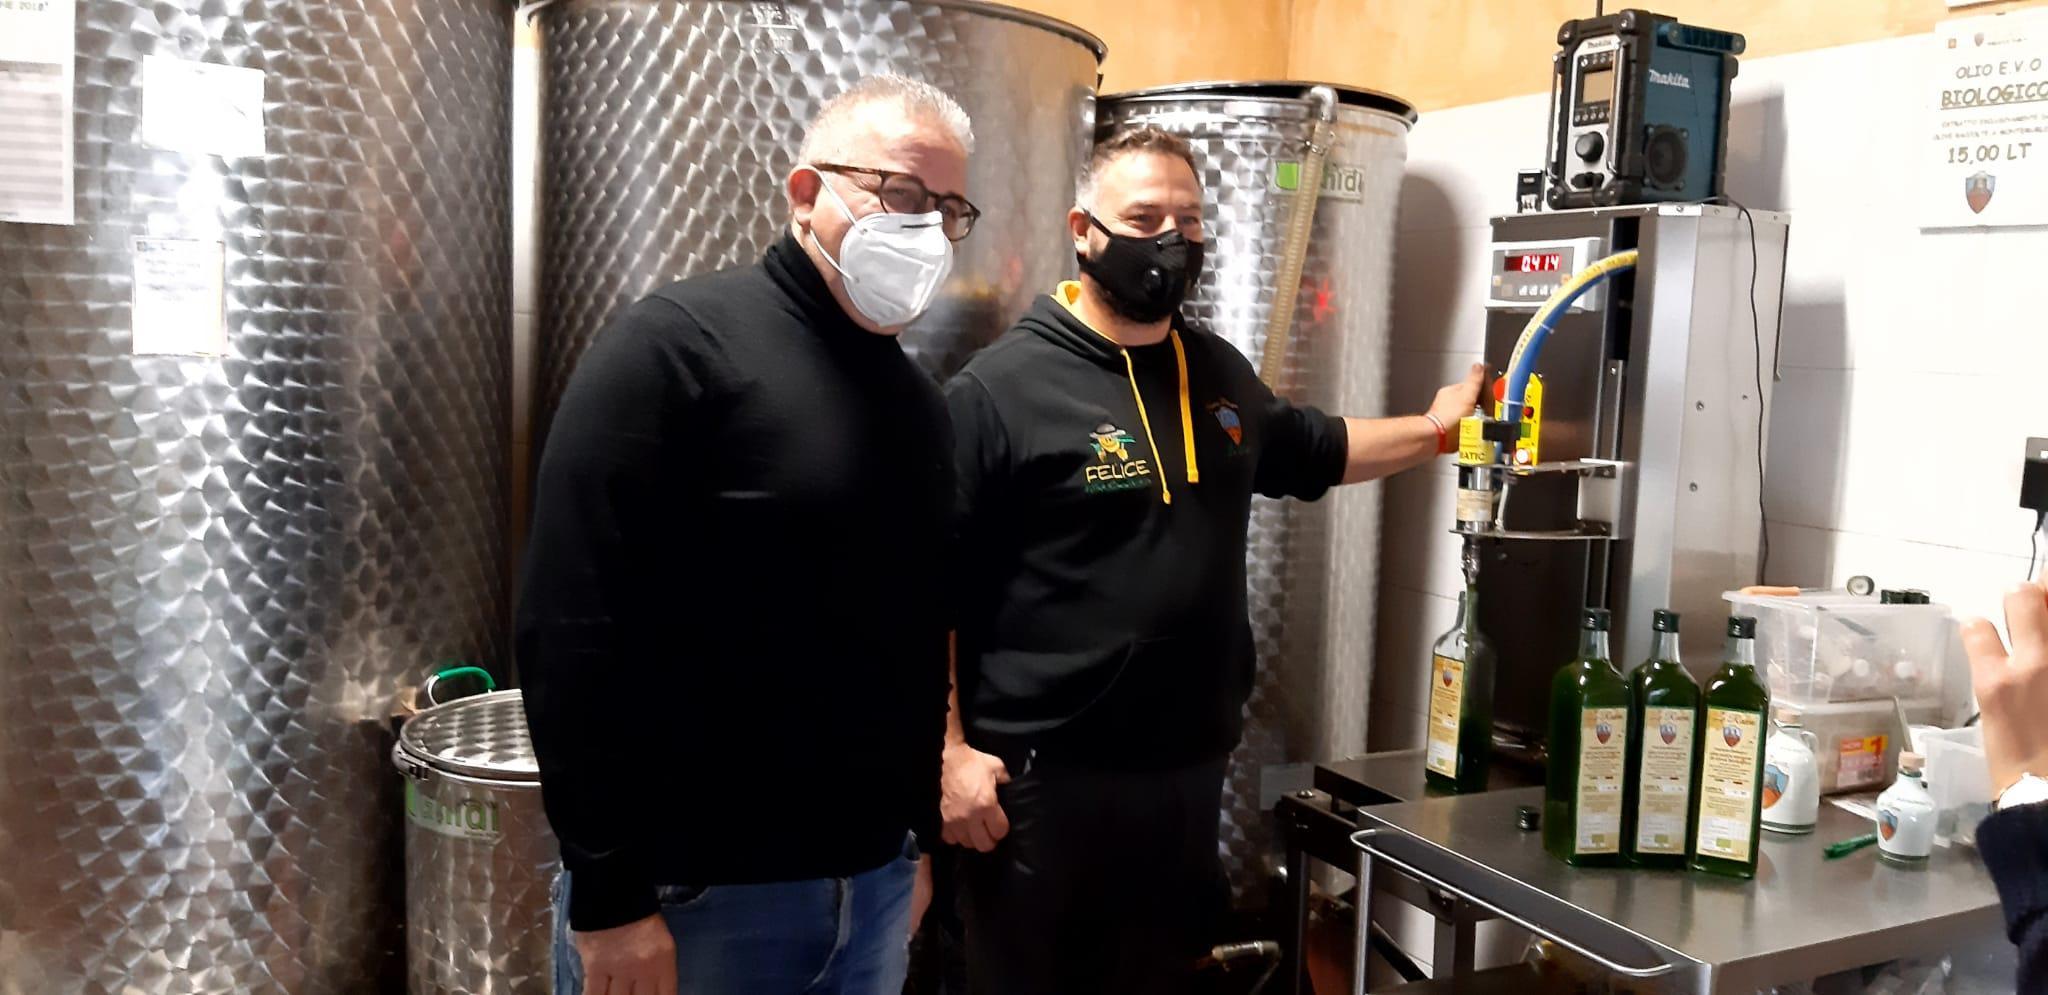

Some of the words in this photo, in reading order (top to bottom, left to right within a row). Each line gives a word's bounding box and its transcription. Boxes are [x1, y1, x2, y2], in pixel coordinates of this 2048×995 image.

[1956, 63, 1993, 79] OLIO
[1941, 80, 2048, 108] BIOLOGICO
[1948, 144, 2000, 165] 15,00
[2007, 142, 2033, 161] LT
[1085, 460, 1151, 483] FELICE
